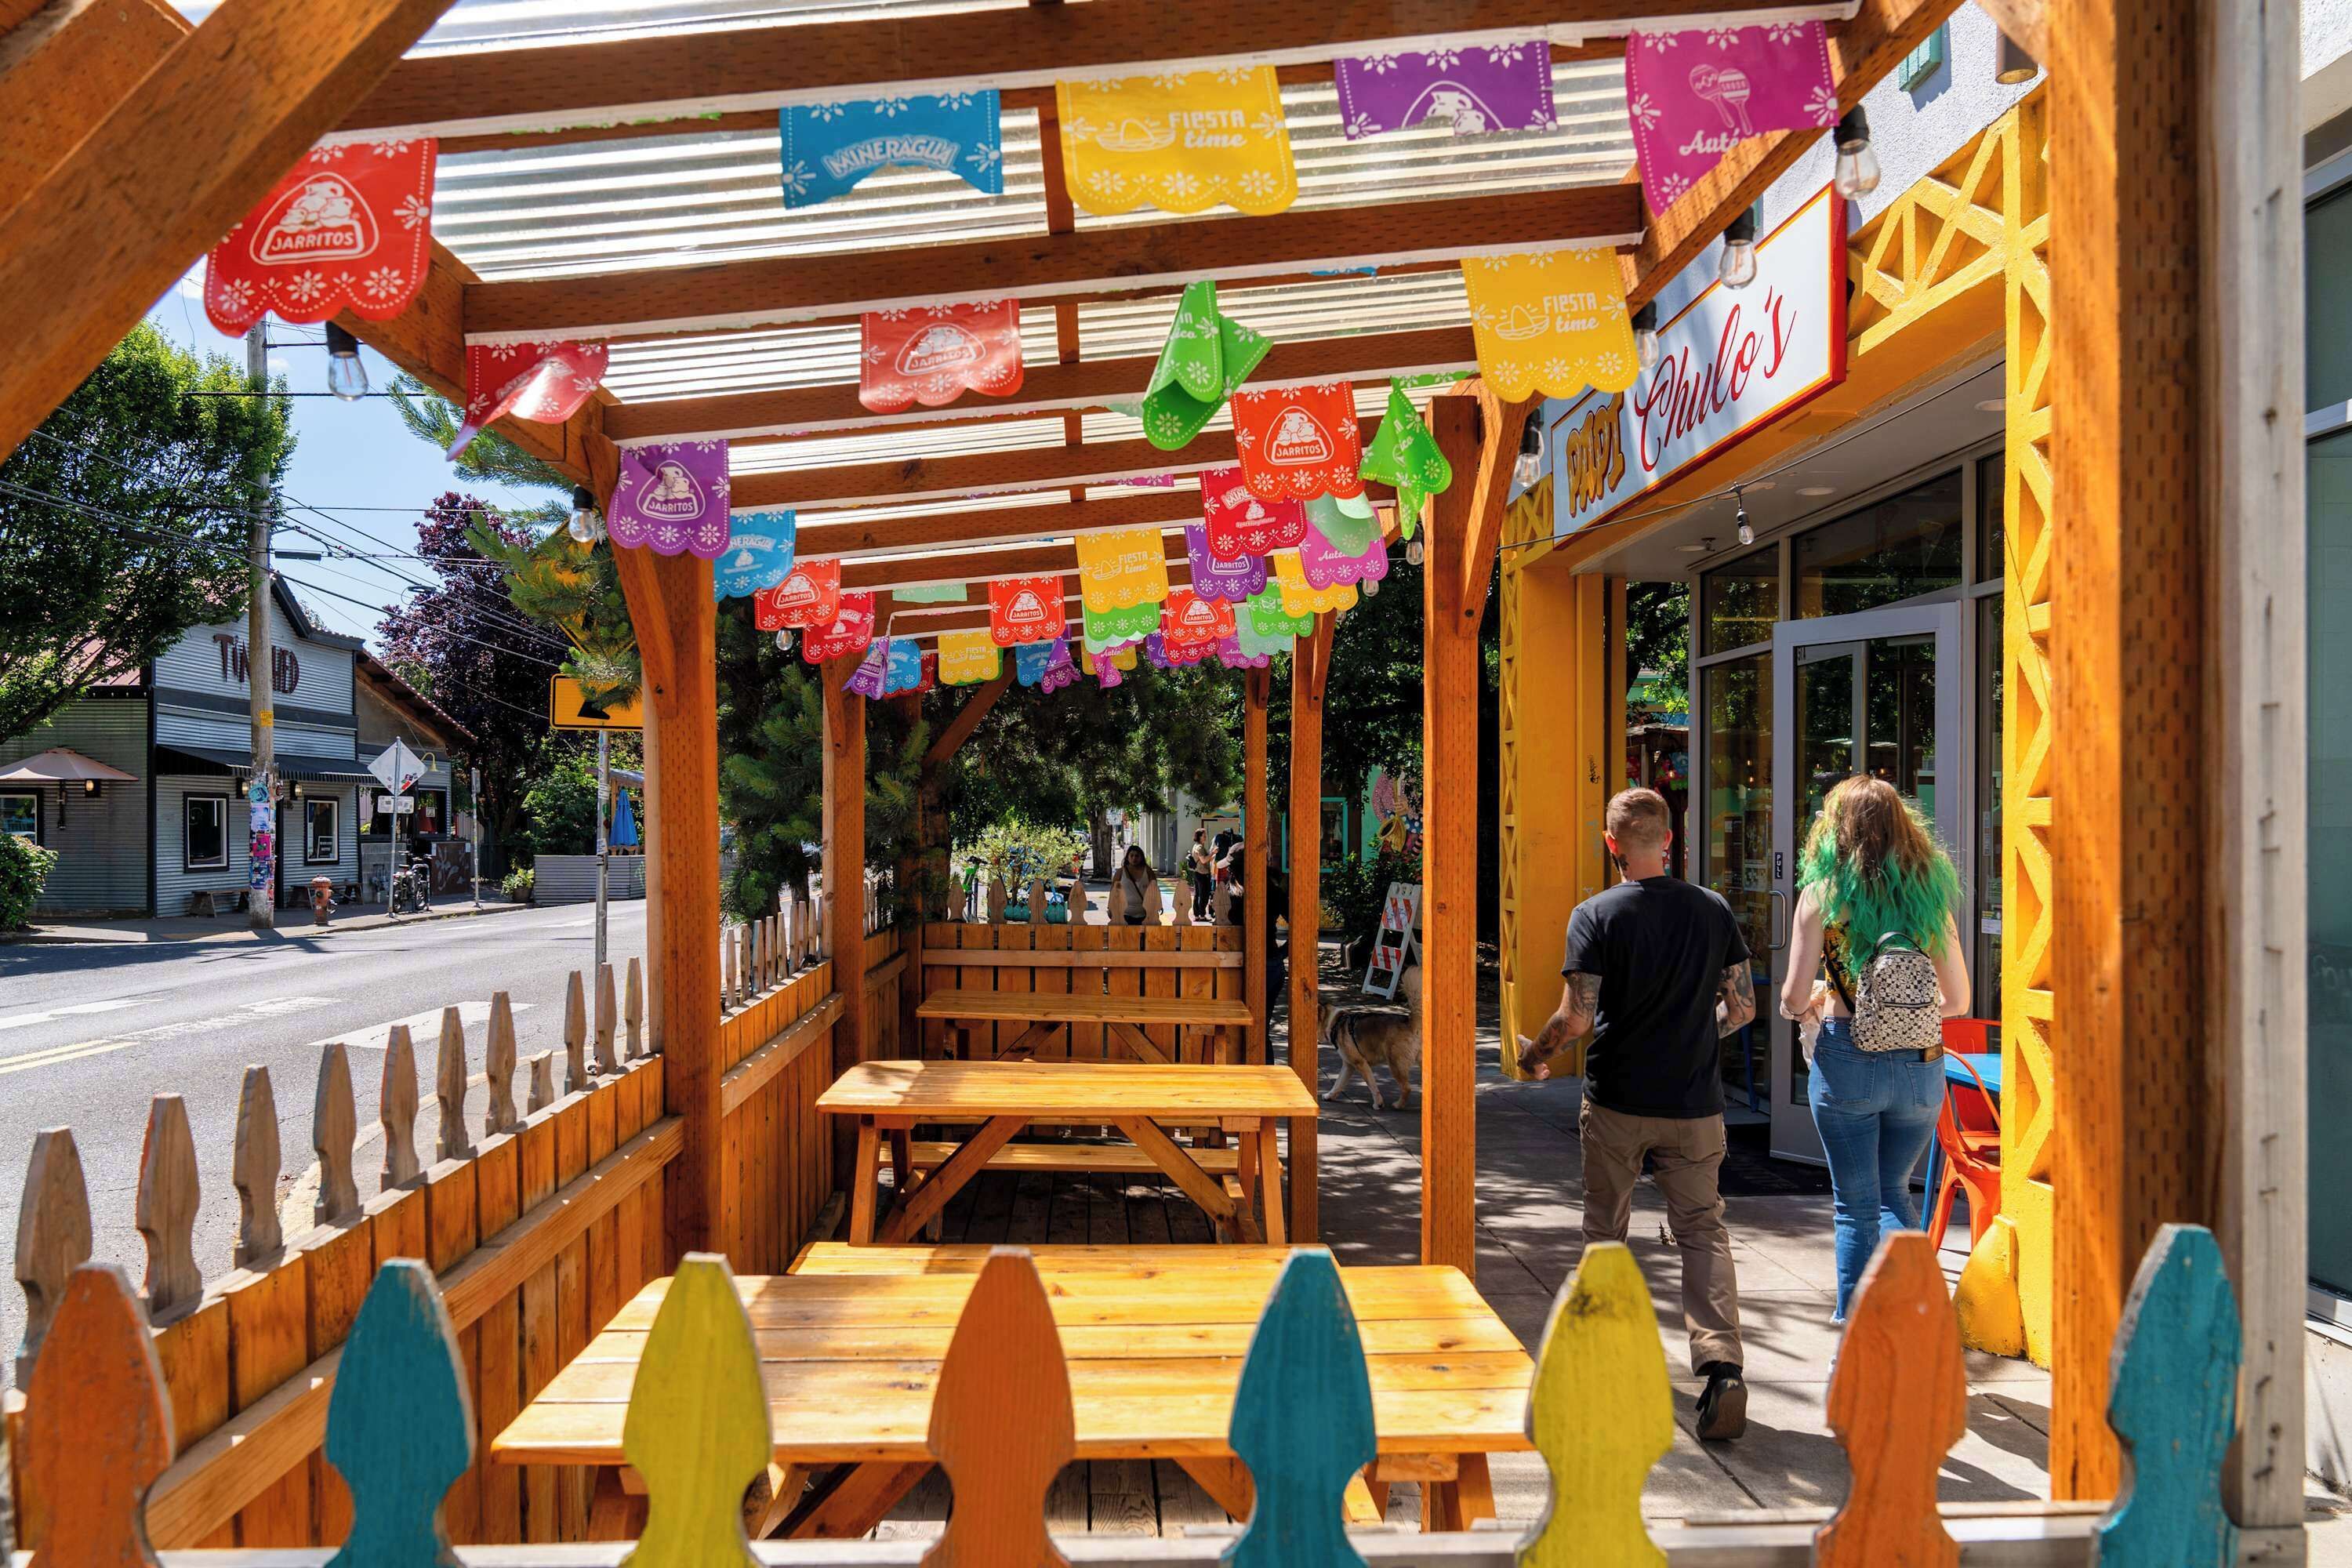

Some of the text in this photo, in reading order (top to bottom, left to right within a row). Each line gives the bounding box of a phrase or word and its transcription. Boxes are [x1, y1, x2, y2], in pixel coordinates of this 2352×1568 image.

[1168, 108, 1246, 129] FIESTA
[1184, 129, 1248, 149] time
[270, 230, 354, 252] JARRITOS
[1542, 292, 1598, 314] FIESTA
[1555, 313, 1600, 333] time
[911, 349, 970, 368] JARRITOS
[1635, 285, 1797, 472] Chulo's
[1276, 444, 1321, 457] JARRITOS
[648, 501, 694, 513] JARRITOS
[726, 533, 777, 553] NERAGUA
[1118, 551, 1149, 564] FIESTA
[1215, 561, 1247, 569] JARRITOS
[780, 592, 811, 604] JARRITOS
[270, 644, 299, 693] HED
